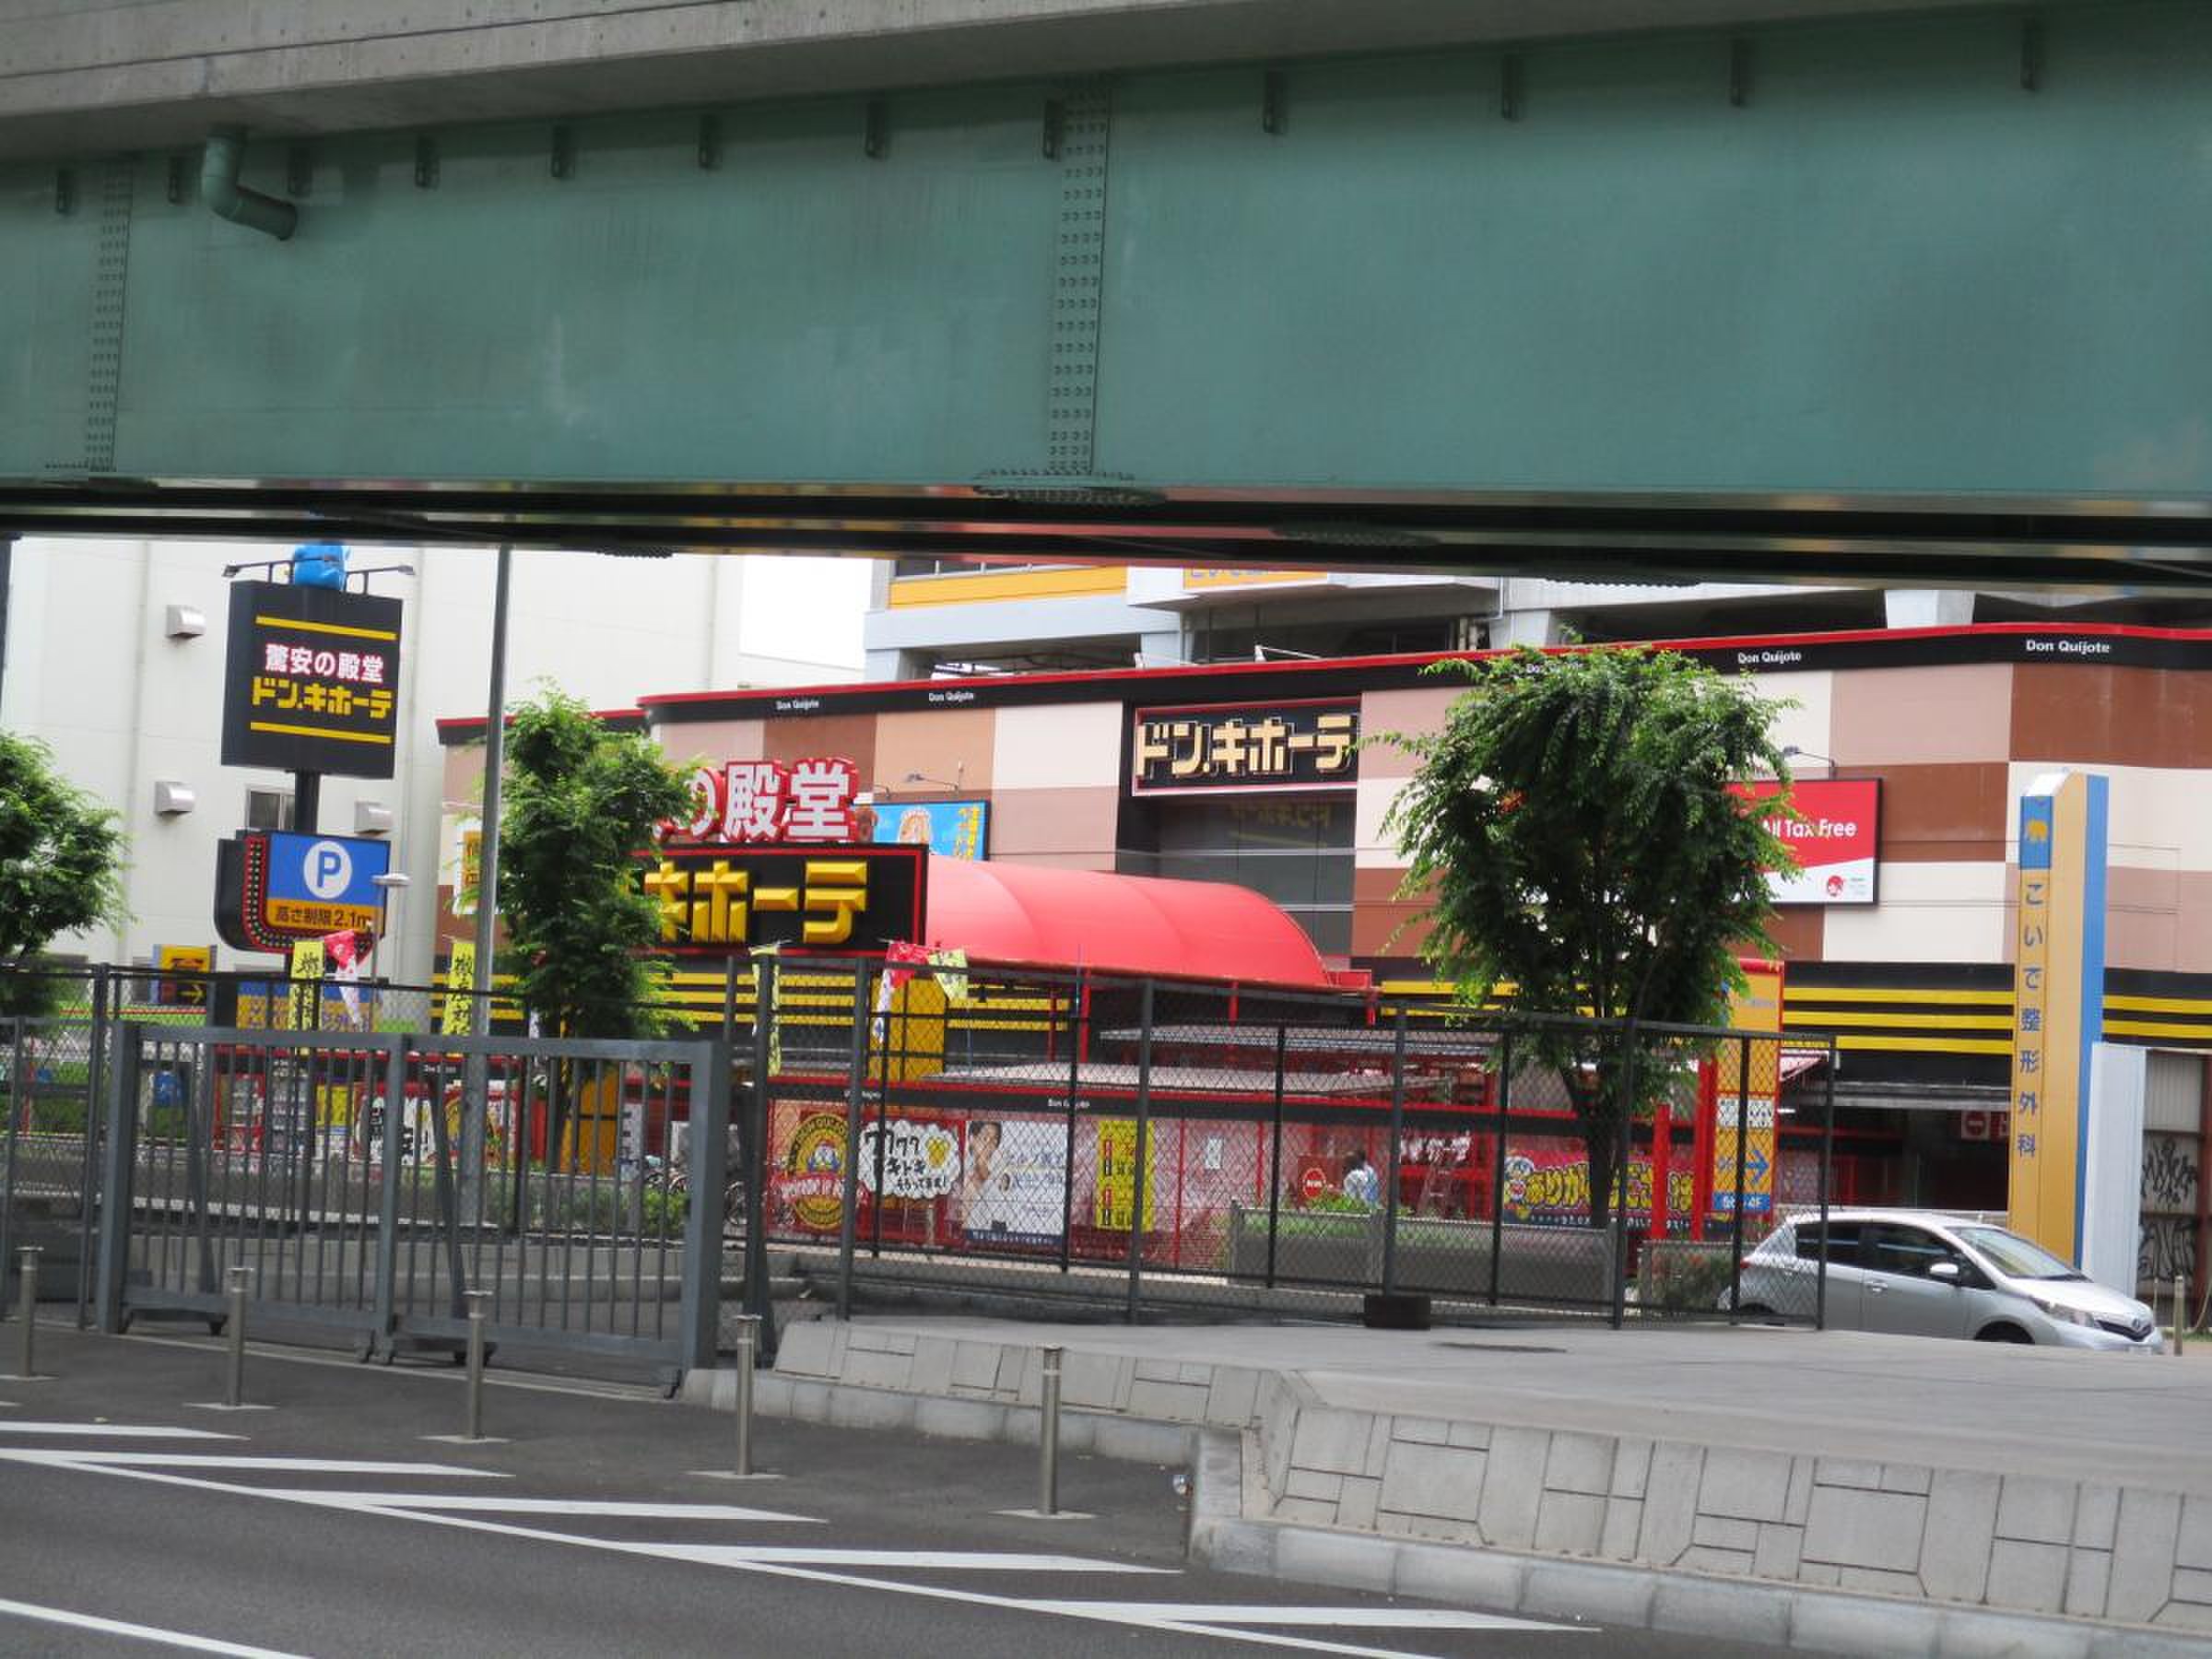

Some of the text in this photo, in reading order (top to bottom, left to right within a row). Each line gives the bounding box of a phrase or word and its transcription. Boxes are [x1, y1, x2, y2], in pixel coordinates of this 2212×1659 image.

[2026, 638, 2111, 655] Don Quijote
[265, 643, 384, 683] 驚安の殿堂
[1737, 651, 1802, 665] Don Quijote
[928, 692, 945, 701] Don
[1784, 819, 1814, 838] Tax
[1818, 818, 1857, 838] Free
[316, 851, 342, 888] P
[2018, 883, 2044, 1159] こいで整形外科
